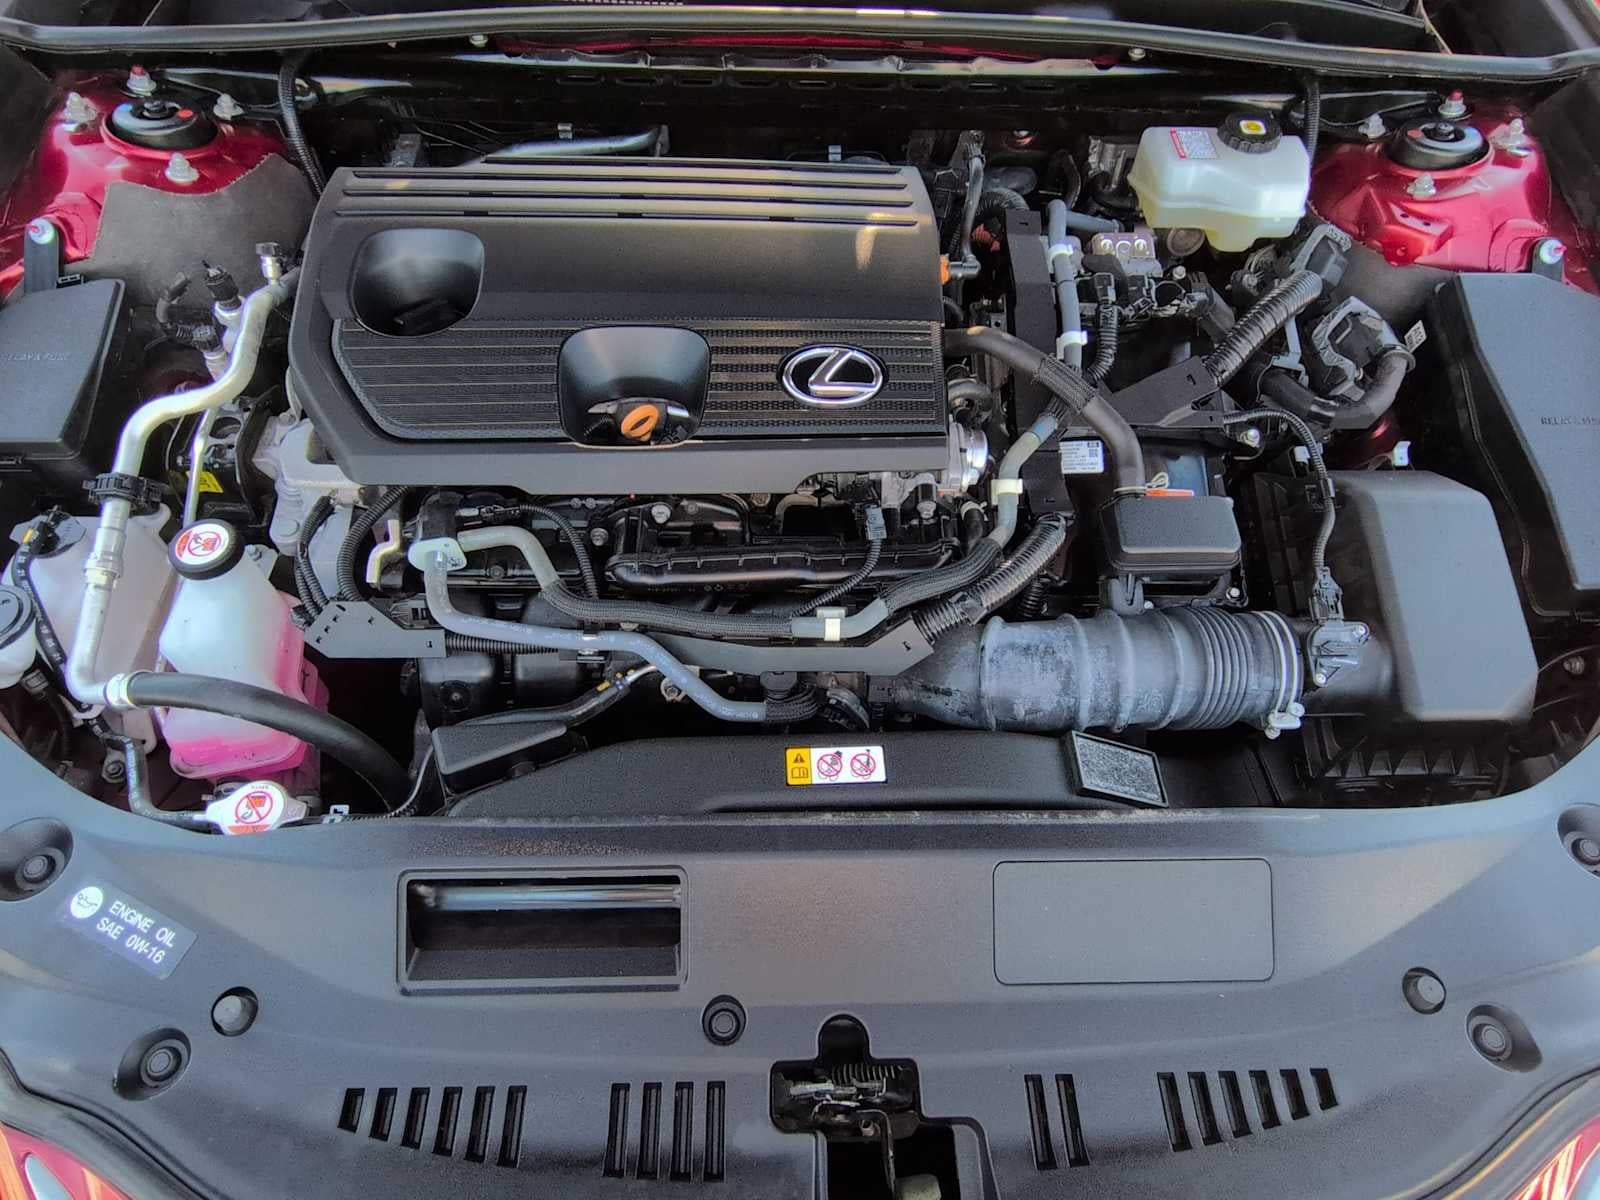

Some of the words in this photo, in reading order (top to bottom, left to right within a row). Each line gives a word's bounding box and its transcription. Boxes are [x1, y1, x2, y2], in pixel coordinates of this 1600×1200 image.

[97, 917, 124, 940] SAE
[125, 934, 165, 964] 0W-16
[109, 900, 154, 933] ENGINE
[155, 927, 176, 948] OIL
